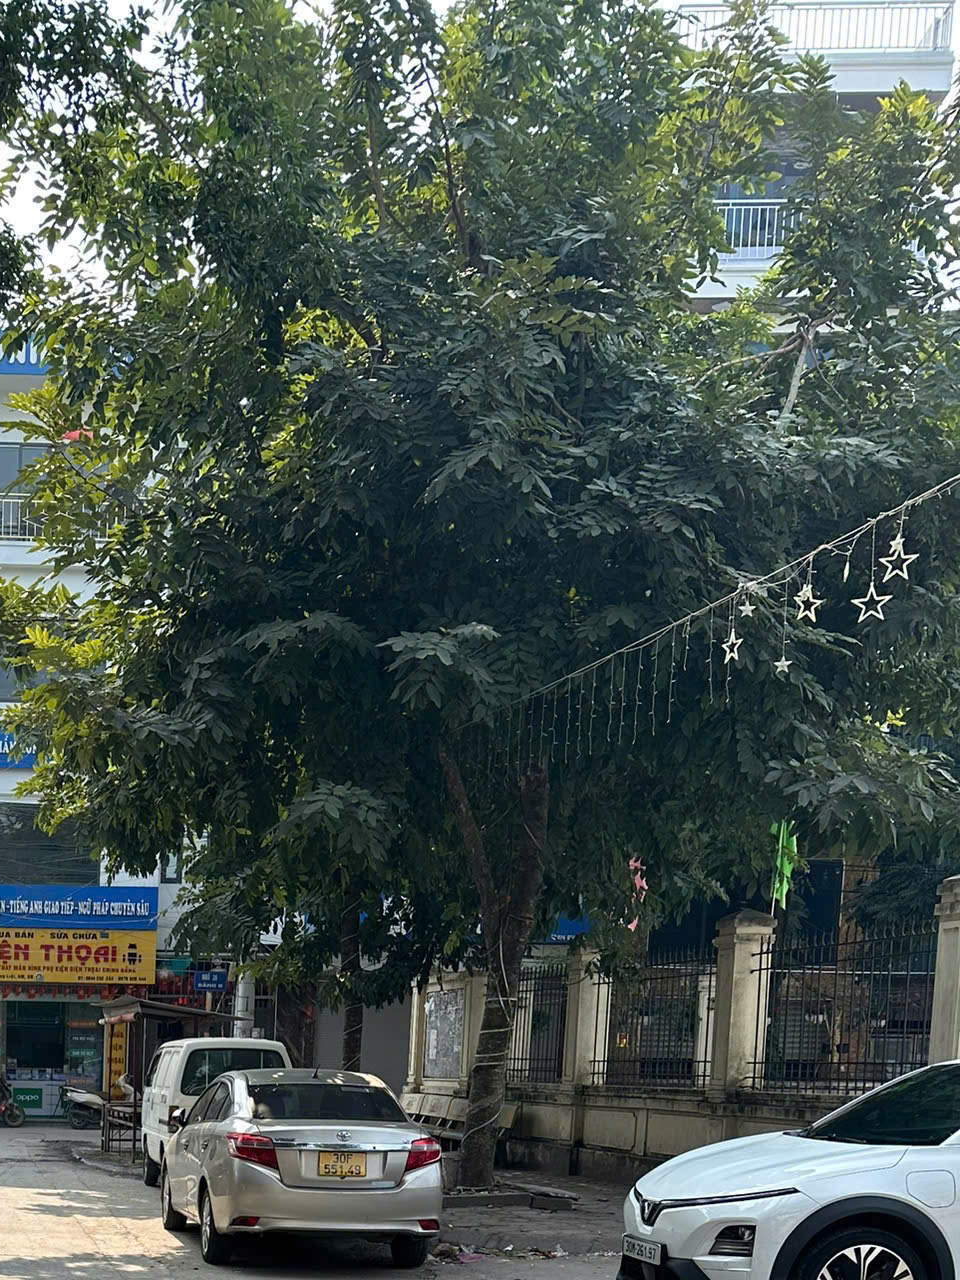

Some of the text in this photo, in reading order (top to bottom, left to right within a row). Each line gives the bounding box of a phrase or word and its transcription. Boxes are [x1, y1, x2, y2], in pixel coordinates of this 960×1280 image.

[10, 896, 29, 914] TIẾNG
[30, 900, 43, 914] ANH
[44, 901, 59, 914] GIAO
[60, 896, 74, 915] TIẾP
[79, 898, 92, 915] NGỮ
[92, 899, 109, 915] PHÁP
[110, 899, 136, 916] CHUYÊN
[137, 899, 150, 916] SÂU
[16, 1093, 39, 1103] oppo
[332, 1153, 353, 1164] 30F
[323, 1164, 361, 1176] 551.49
